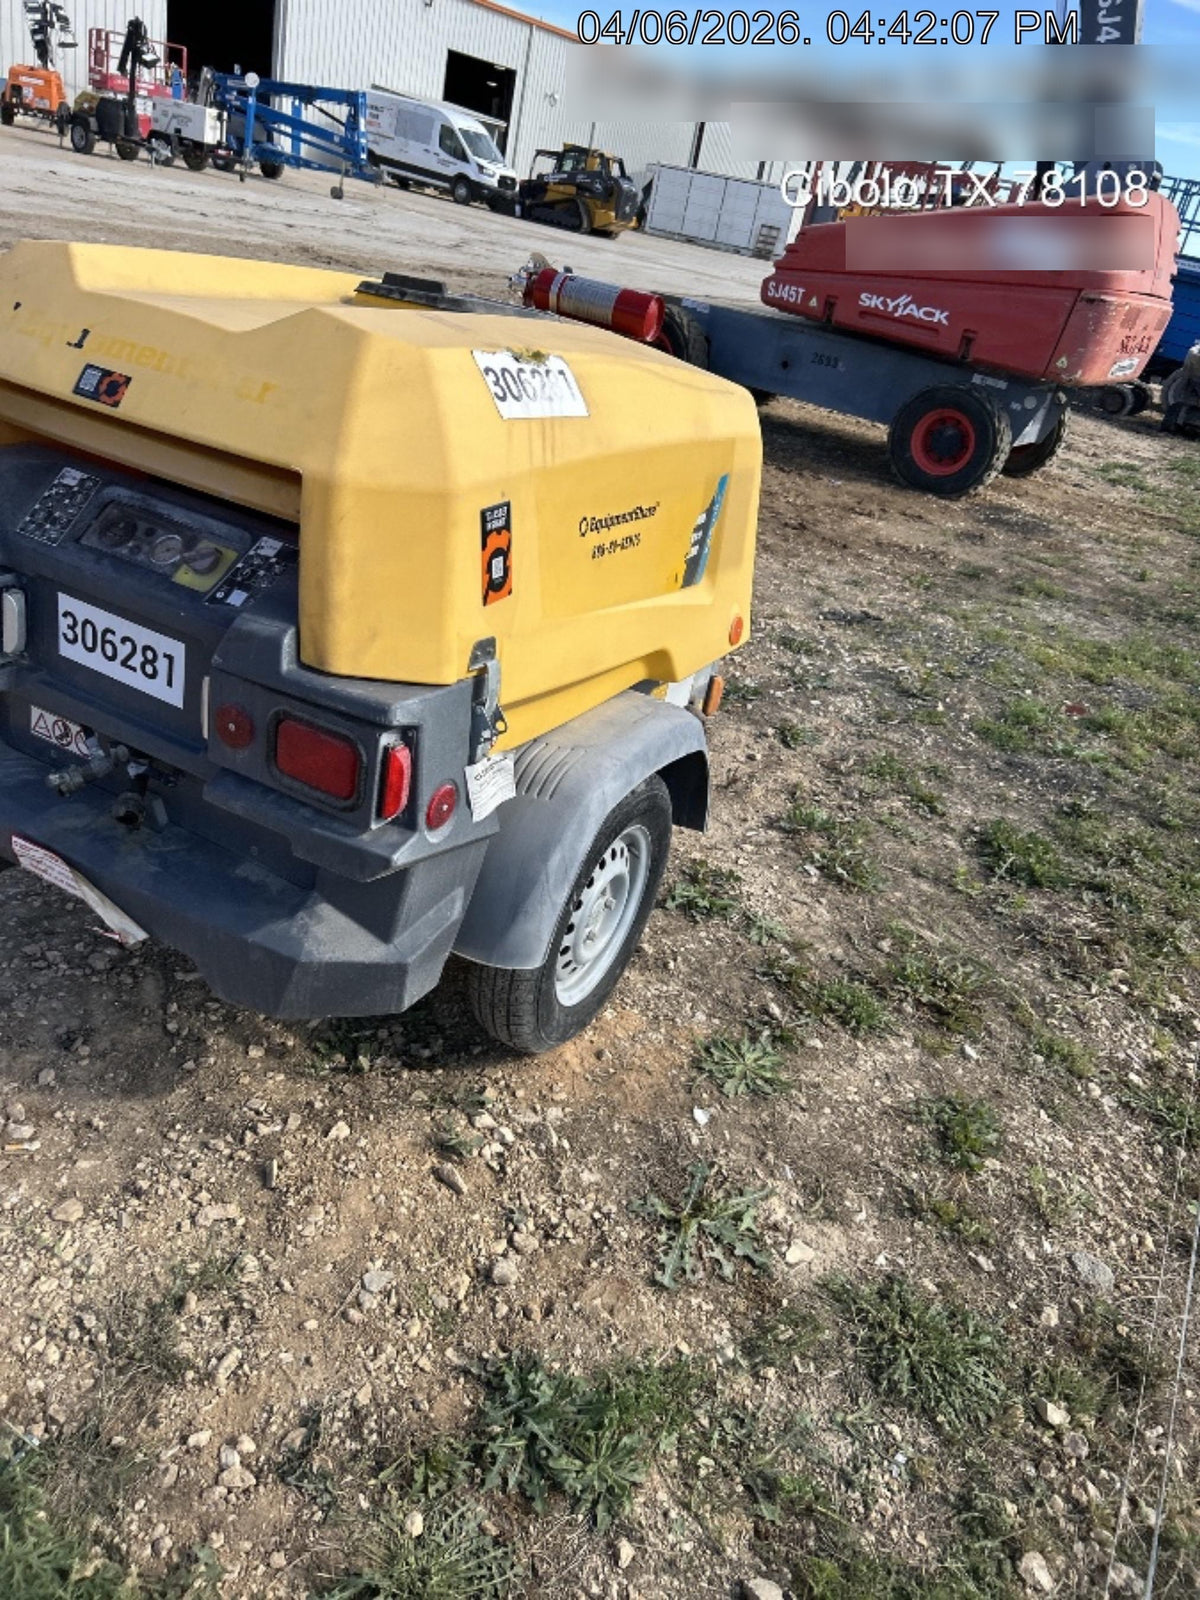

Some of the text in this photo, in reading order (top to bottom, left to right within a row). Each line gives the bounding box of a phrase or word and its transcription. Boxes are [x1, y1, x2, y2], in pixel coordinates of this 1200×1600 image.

[767, 281, 806, 305] SJ45T
[858, 293, 949, 325] SKYJACK
[61, 610, 174, 689] 306281
